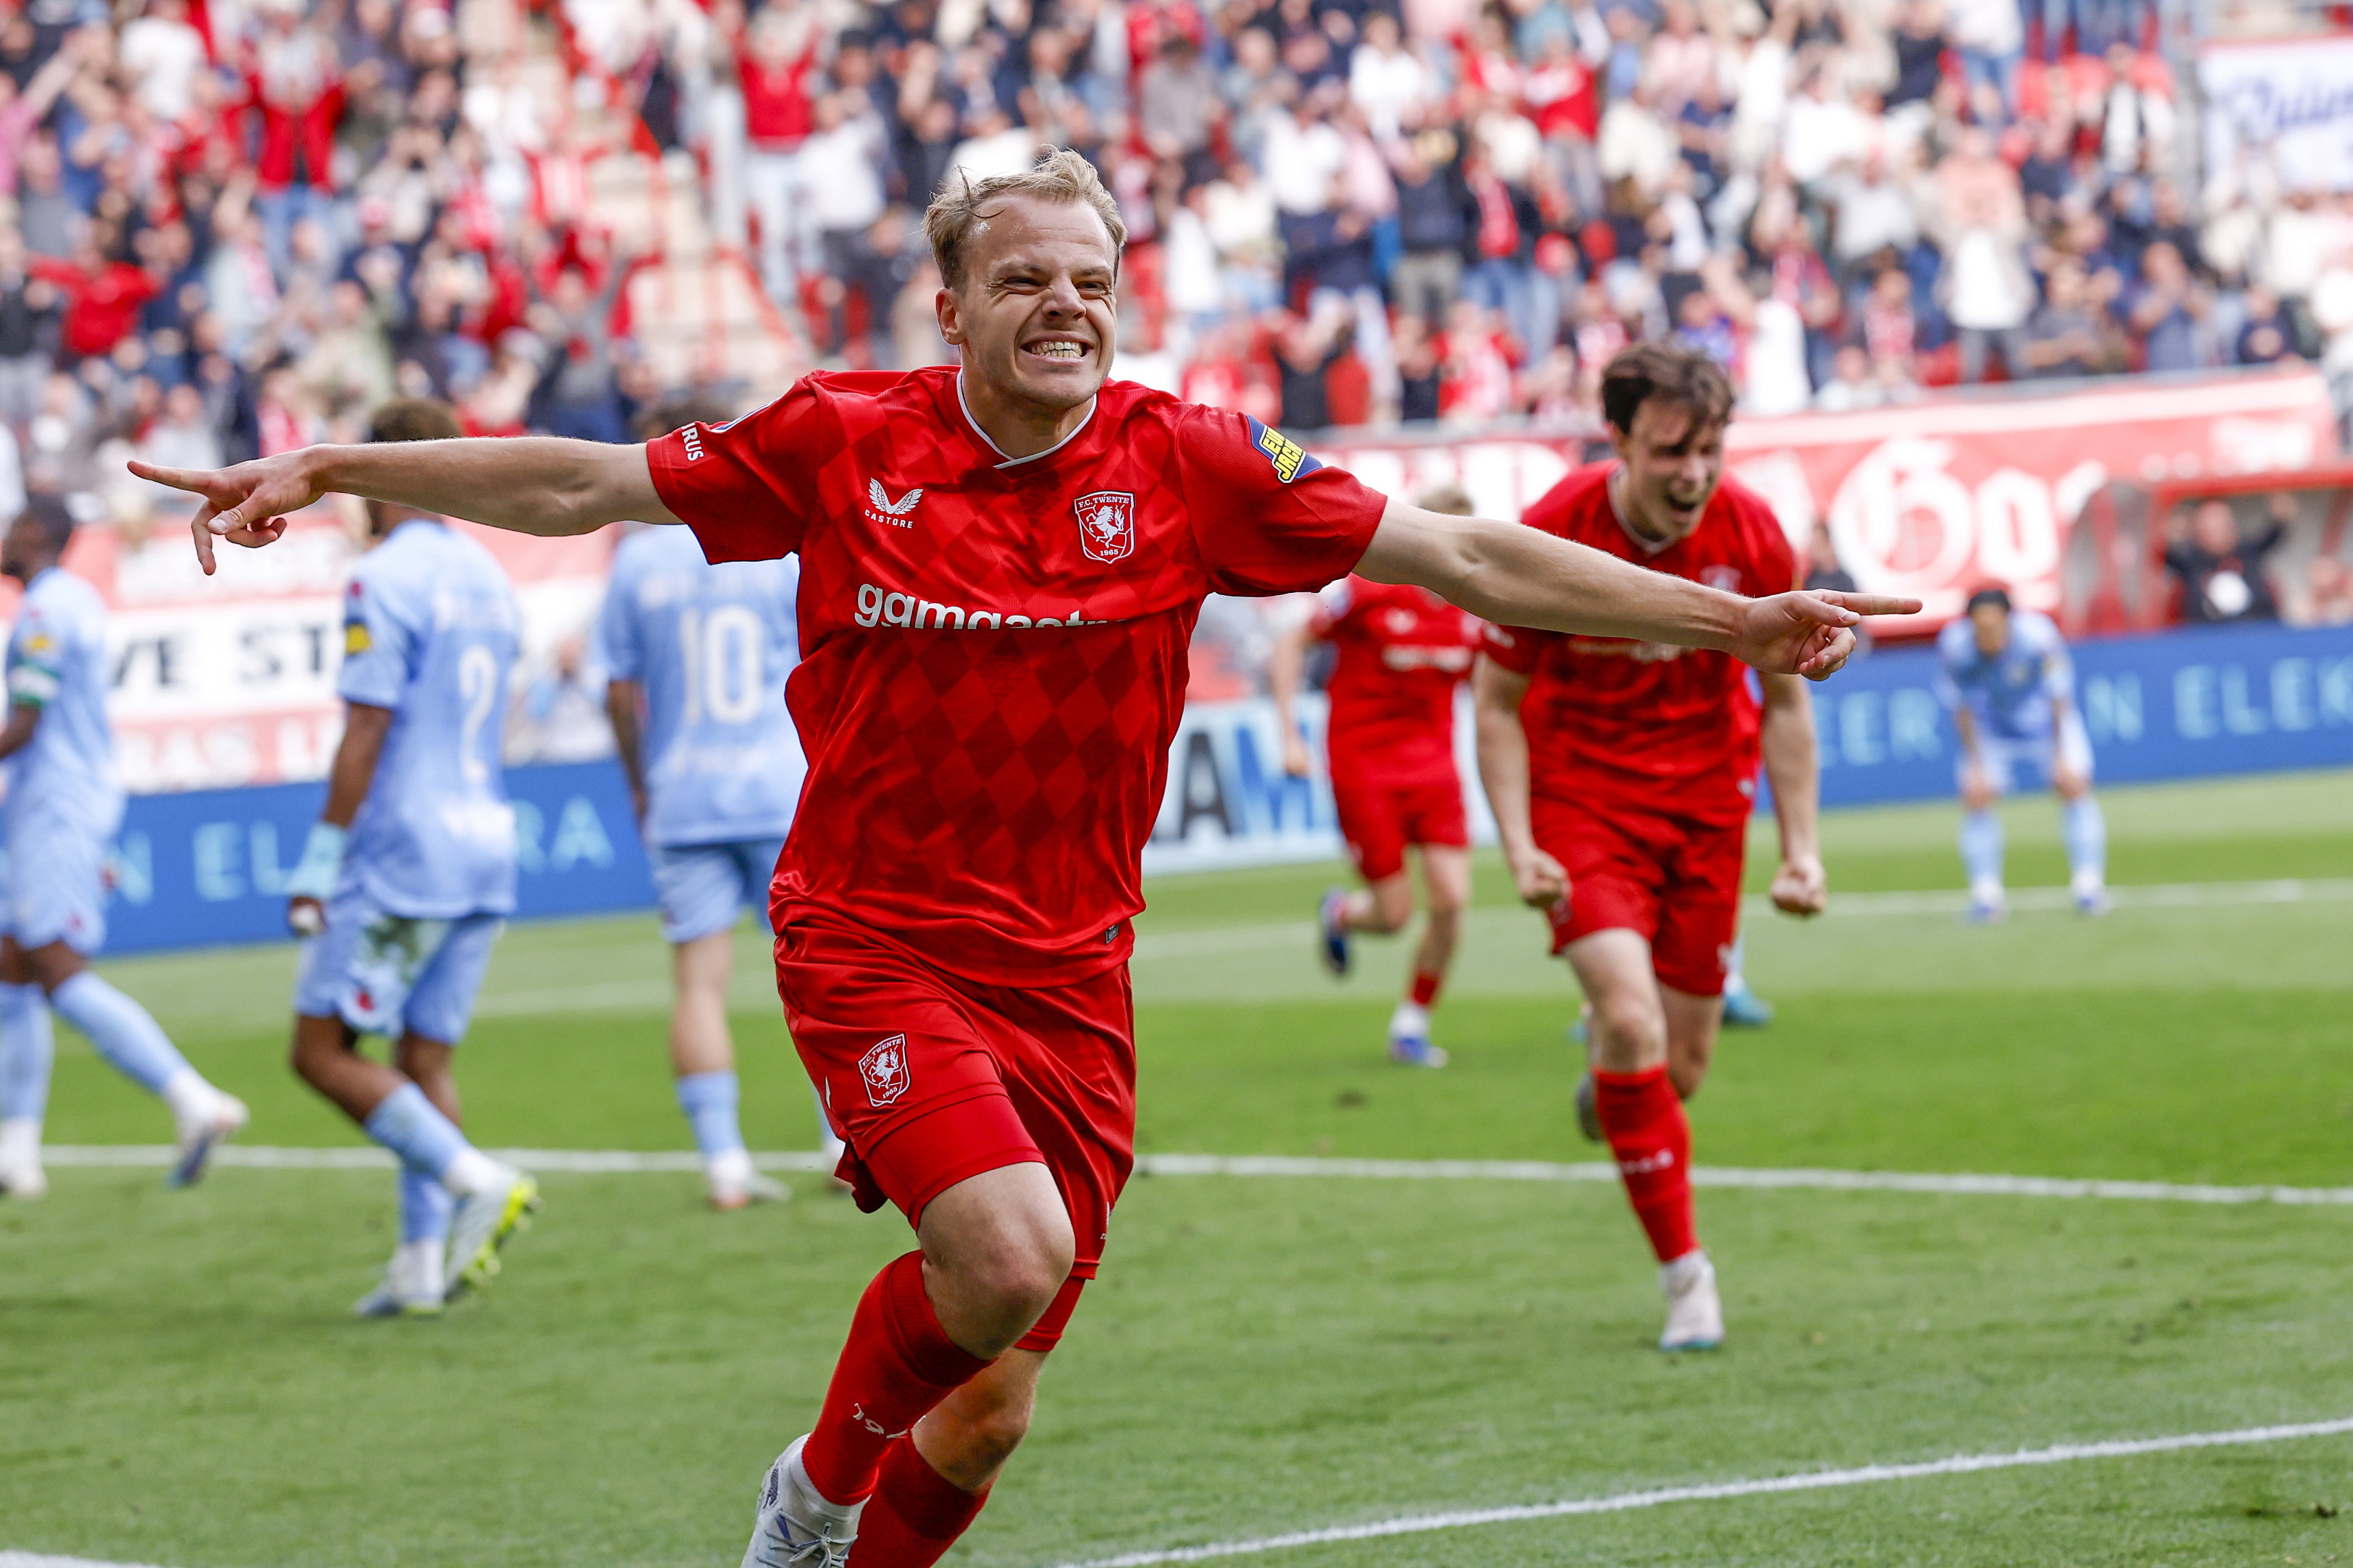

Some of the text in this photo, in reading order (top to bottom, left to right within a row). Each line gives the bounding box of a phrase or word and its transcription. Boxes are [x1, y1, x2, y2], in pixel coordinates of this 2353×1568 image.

[864, 509, 913, 529] CASTORE
[678, 604, 765, 726] 10
[458, 642, 500, 785] 2
[872, 1038, 901, 1056] TWENTE
[883, 1086, 898, 1099] 1965
